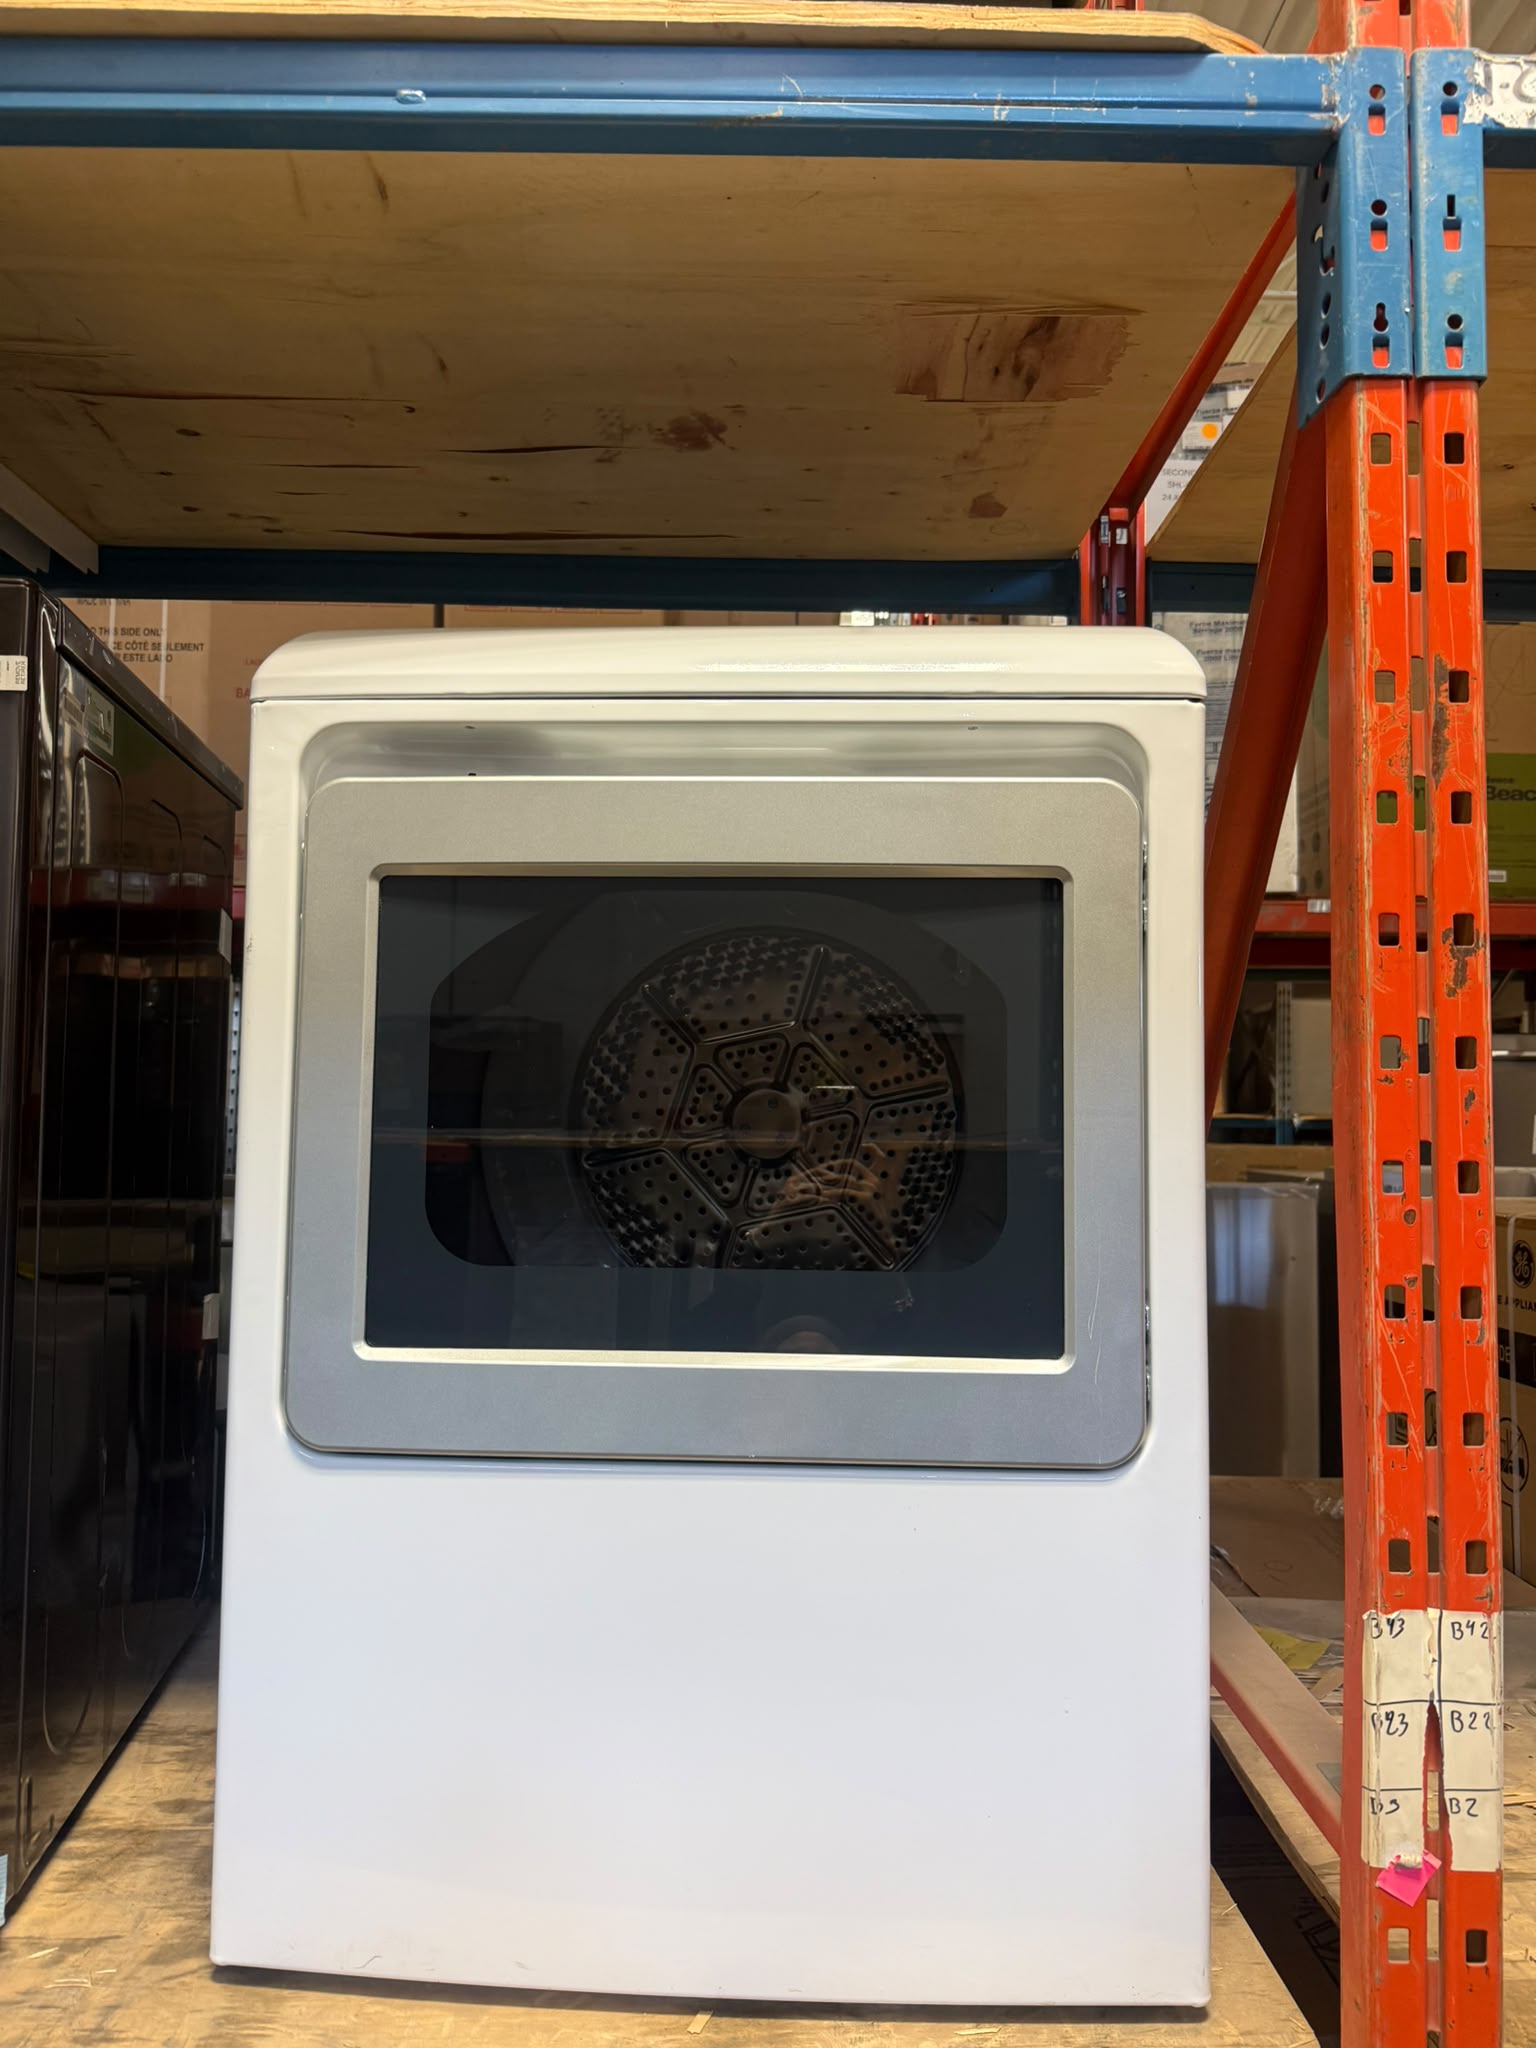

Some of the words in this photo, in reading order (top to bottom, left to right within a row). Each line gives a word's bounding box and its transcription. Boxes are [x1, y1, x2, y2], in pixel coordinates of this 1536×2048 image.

[99, 627, 118, 636] THS
[121, 627, 141, 636] SIDE
[143, 627, 165, 637] ONL
[124, 640, 149, 651] CÔTÉ
[123, 653, 145, 662] ESTE
[148, 654, 173, 663] LAO
[1504, 1296, 1536, 1312] APLIA
[1450, 1619, 1494, 1641] B42
[1450, 1710, 1494, 1733] B22
[1449, 1797, 1479, 1818] B2
